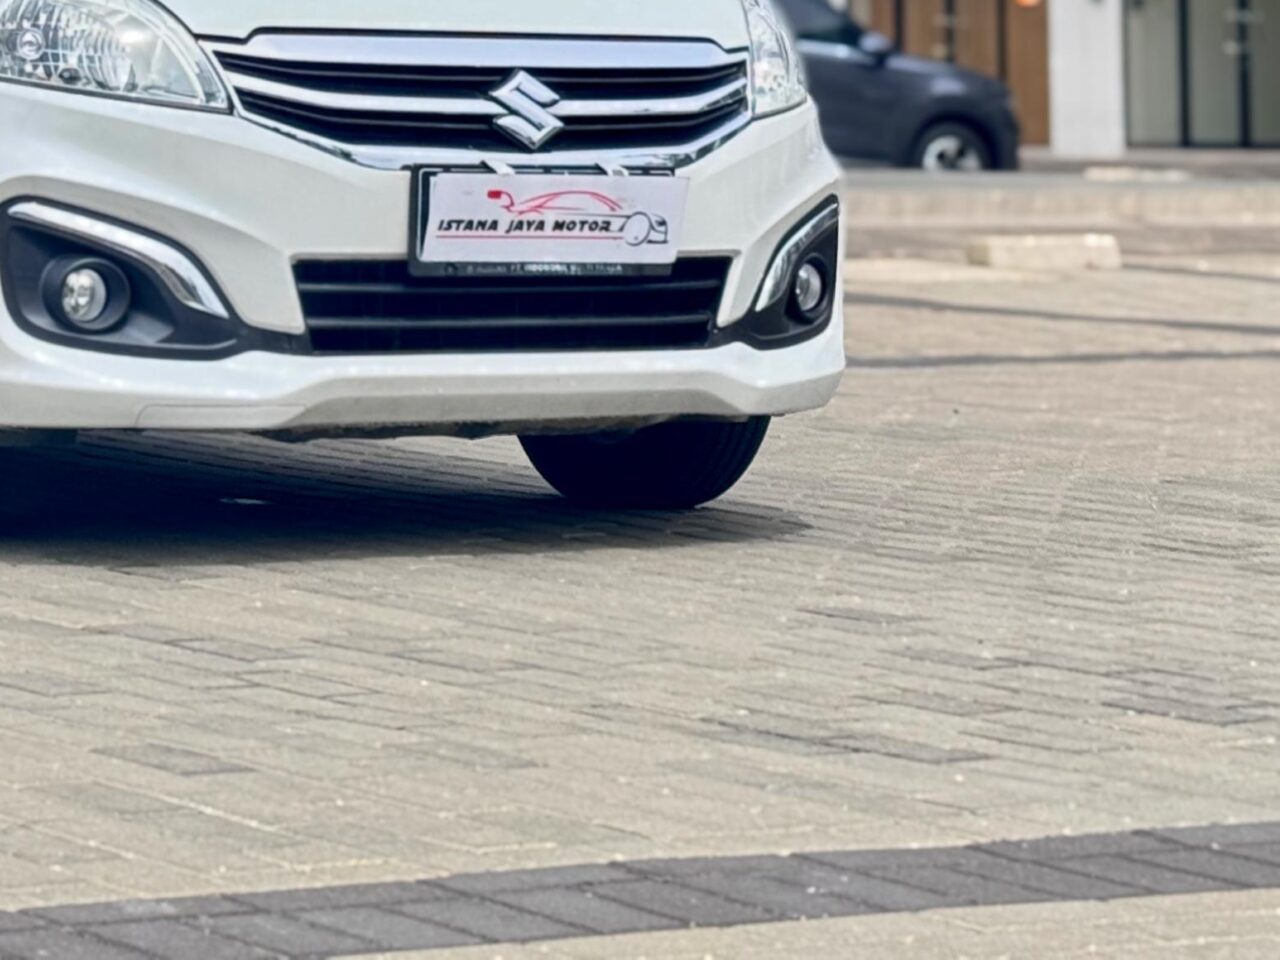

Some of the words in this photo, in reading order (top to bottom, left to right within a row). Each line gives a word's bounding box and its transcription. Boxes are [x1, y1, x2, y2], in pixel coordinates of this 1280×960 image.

[437, 218, 499, 232] ISTANA
[504, 218, 546, 235] JAYA
[551, 219, 612, 233] MOTOR
